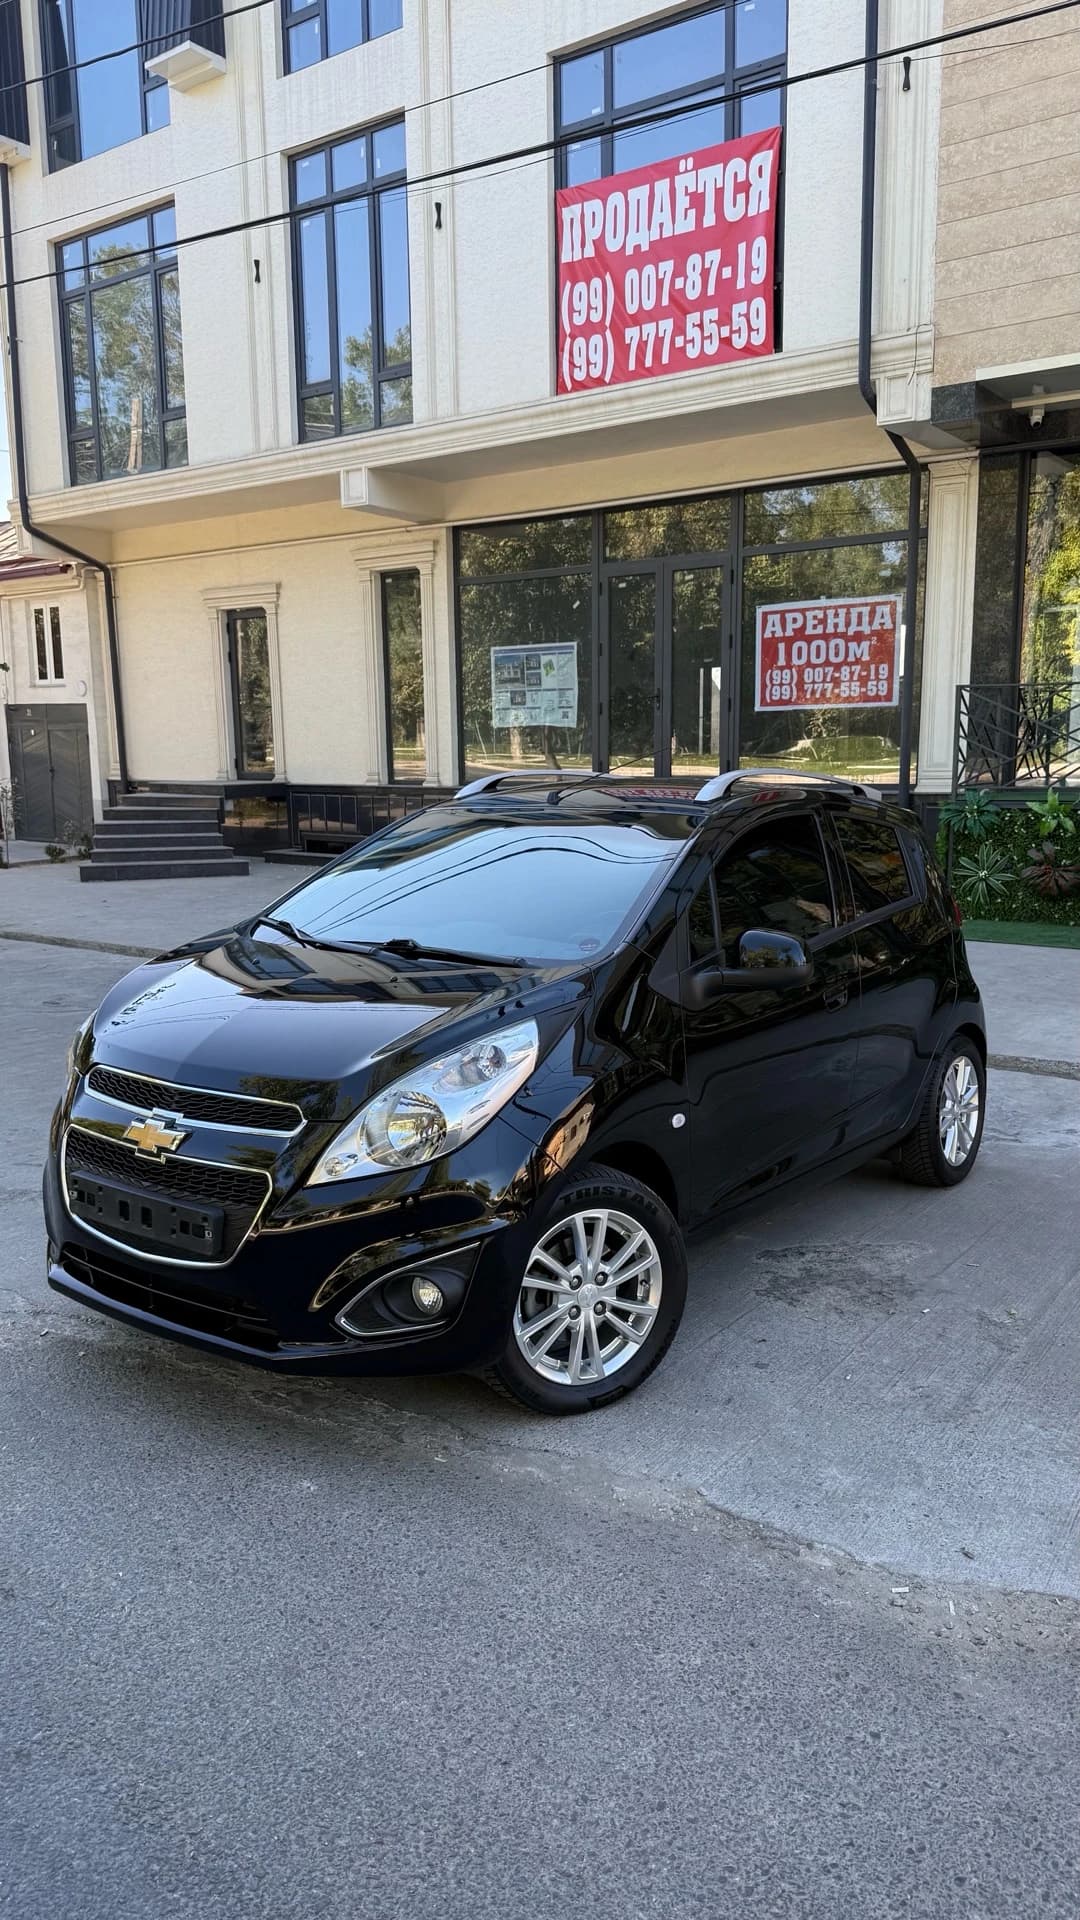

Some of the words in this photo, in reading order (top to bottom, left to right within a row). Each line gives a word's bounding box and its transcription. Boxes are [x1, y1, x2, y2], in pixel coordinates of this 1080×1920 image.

[561, 149, 773, 264] ПРОДАЁТСЯ
[561, 271, 615, 333] (99)
[624, 235, 768, 315] 007-87-19
[562, 327, 615, 392] (99)
[624, 296, 767, 371] 777-55-59
[764, 605, 893, 638] АРЕНДА
[765, 667, 798, 686] (99)
[803, 663, 889, 684] 007-87-19
[765, 684, 797, 703] (99)
[803, 680, 888, 699] 777-55-59
